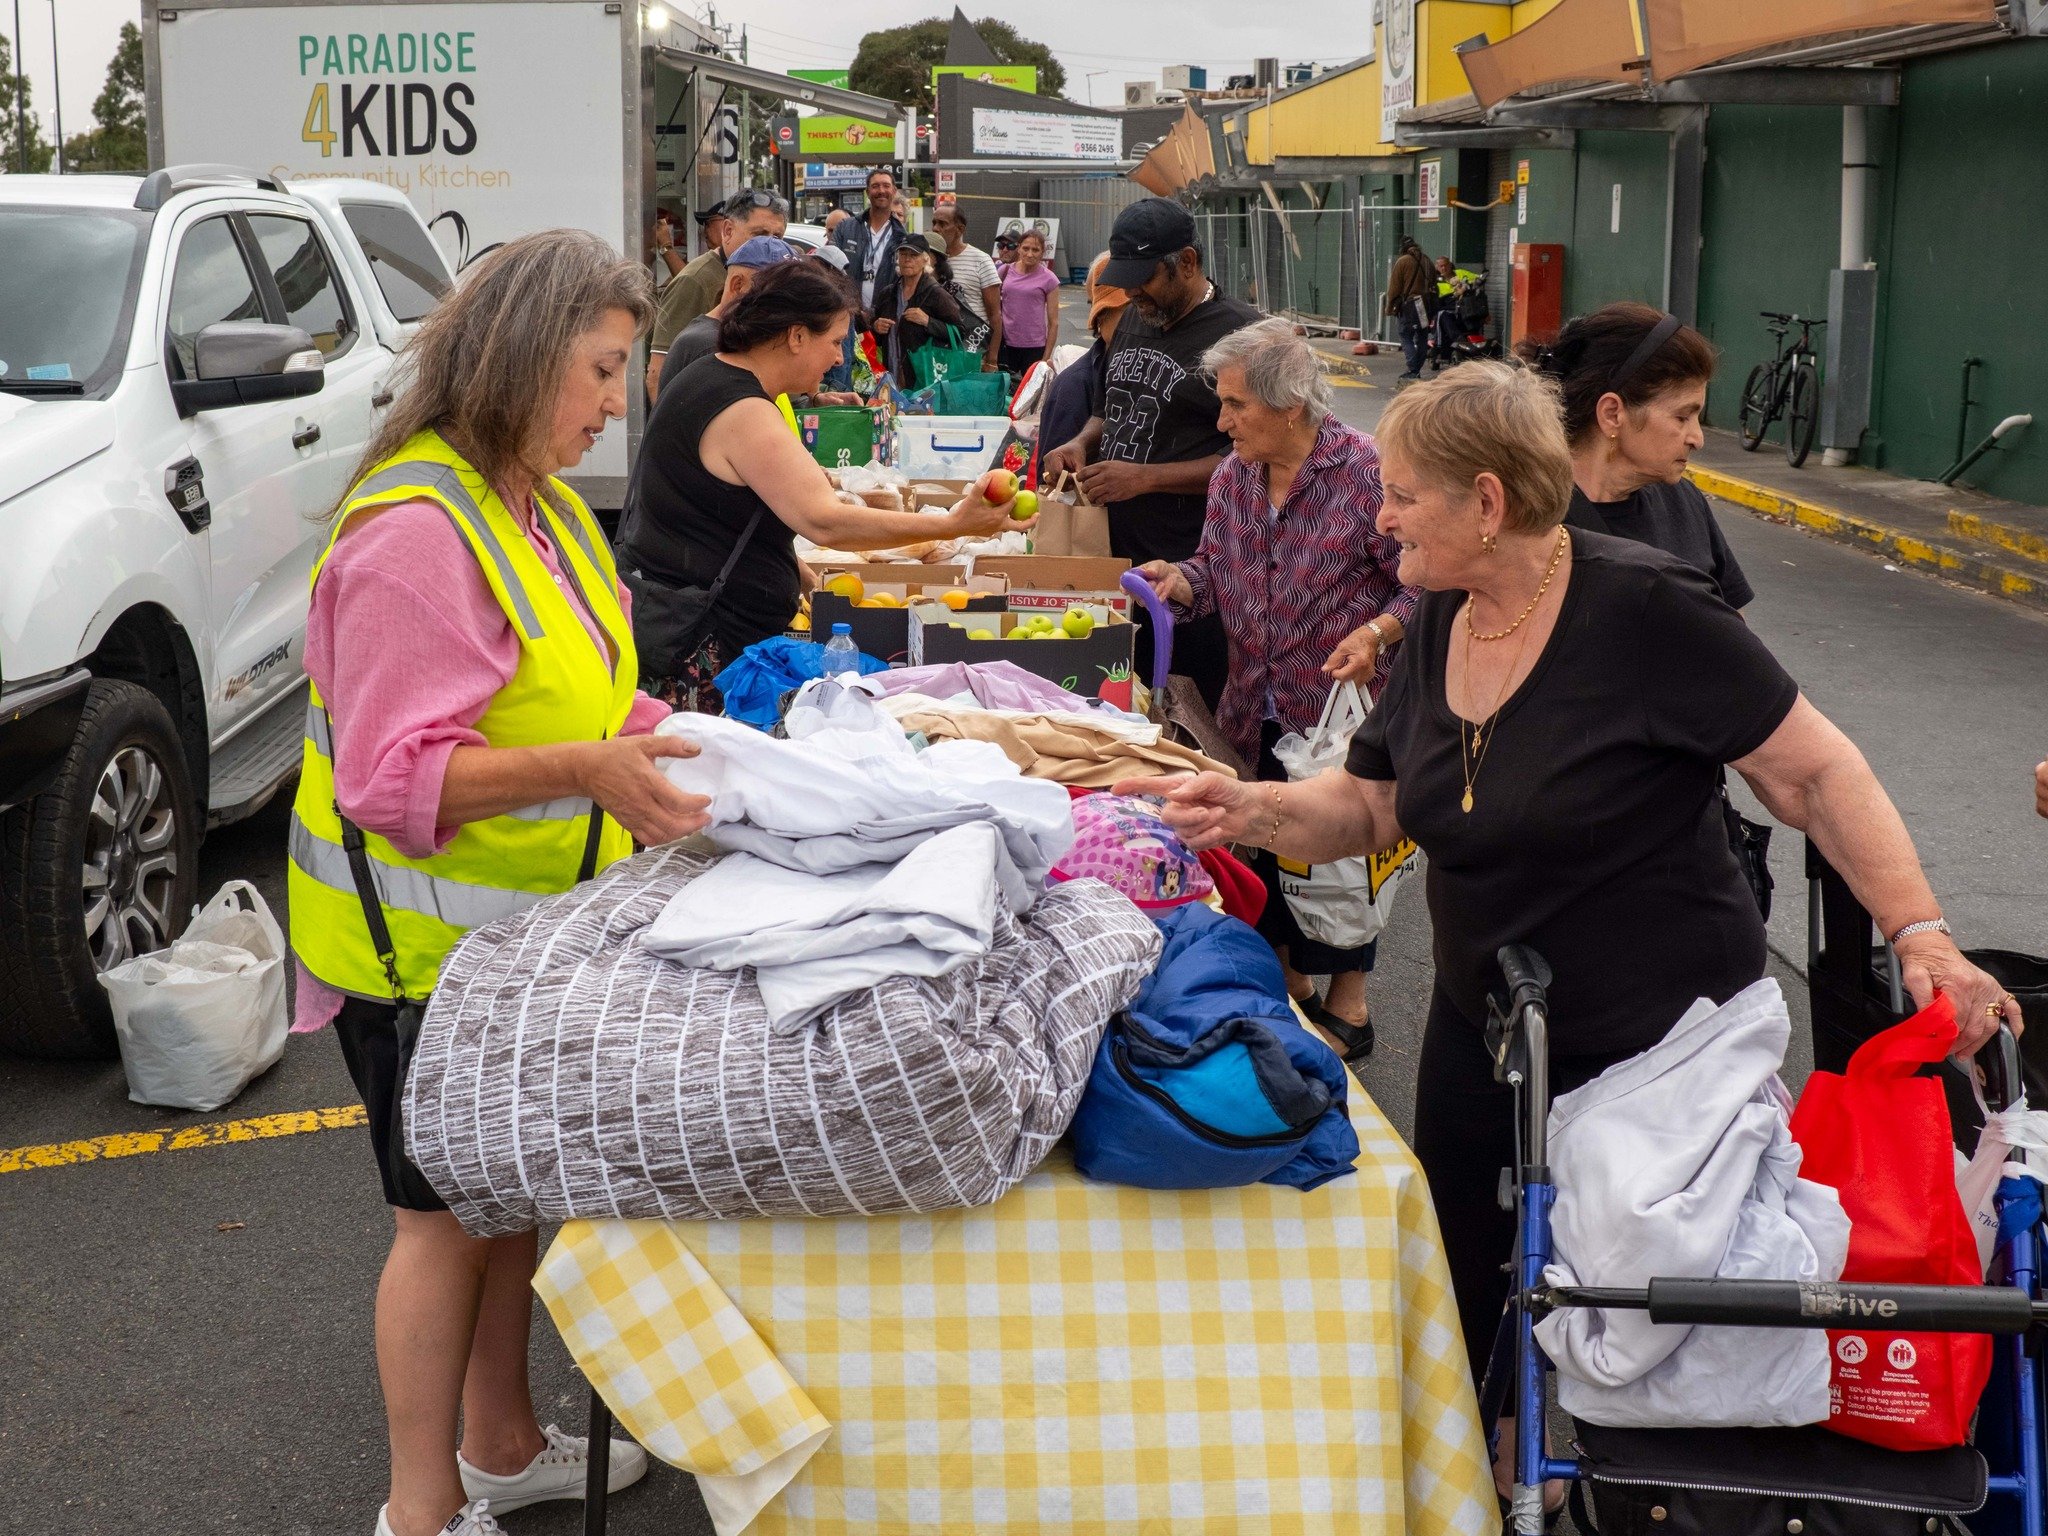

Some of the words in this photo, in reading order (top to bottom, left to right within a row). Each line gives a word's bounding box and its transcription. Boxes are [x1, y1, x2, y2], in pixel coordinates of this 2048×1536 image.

[299, 32, 476, 76] PARADISE
[302, 82, 478, 158] 4KIDS
[807, 131, 843, 139] THIRSTY
[1080, 142, 1098, 152] 9366
[1098, 144, 1114, 153] 2495
[418, 163, 512, 188] Kitchen
[1042, 596, 1058, 606] OF
[224, 637, 293, 703] WILDTRAK
[1833, 1292, 1899, 1318] rive
[1883, 1370, 1914, 1378] Empowers
[1872, 1388, 1880, 1396] the
[1882, 1390, 1906, 1398] proceeds
[1907, 1390, 1920, 1398] from
[1847, 1402, 1865, 1410] Cotton
[1876, 1405, 1905, 1414] Foundation
[1910, 1400, 1930, 1408] funding
[1847, 1410, 1915, 1424] cottononfoundation.org
[447, 1515, 463, 1531] Keds
